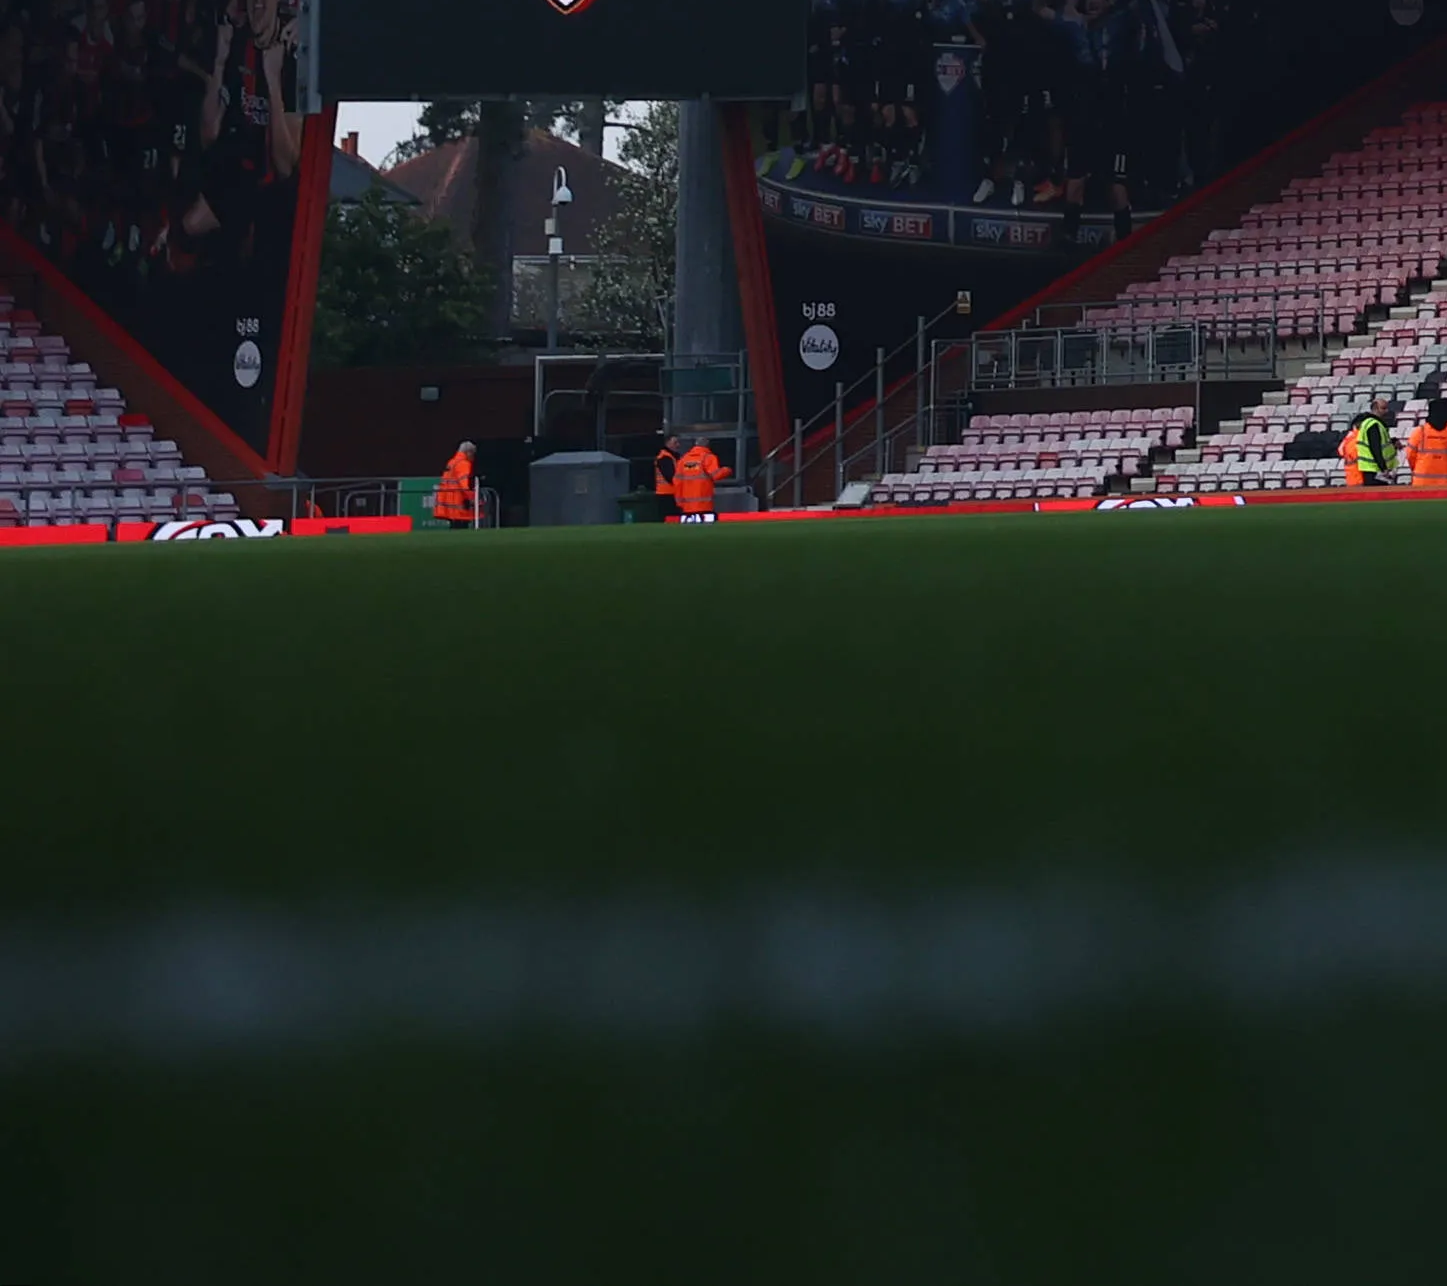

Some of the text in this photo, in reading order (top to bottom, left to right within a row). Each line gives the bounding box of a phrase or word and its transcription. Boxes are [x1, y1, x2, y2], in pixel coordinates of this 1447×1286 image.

[814, 206, 841, 225] BET
[863, 211, 928, 234] sky BET
[975, 221, 1047, 244] sky BET
[802, 302, 836, 321] bj88
